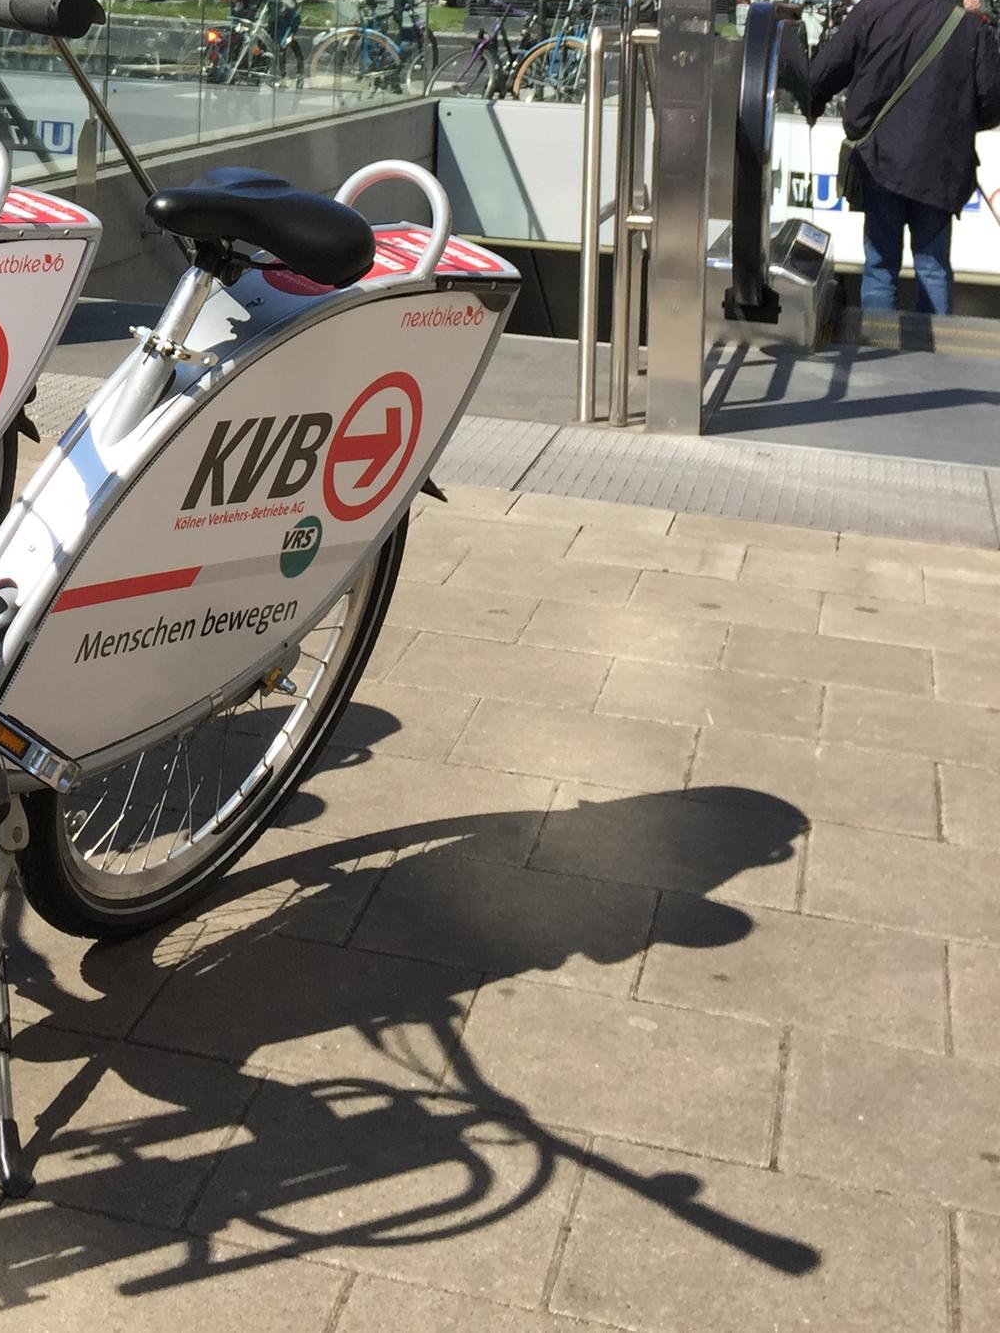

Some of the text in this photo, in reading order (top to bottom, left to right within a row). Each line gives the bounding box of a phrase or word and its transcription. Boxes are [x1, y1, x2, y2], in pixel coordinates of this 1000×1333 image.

[43, 122, 72, 152] U
[401, 306, 462, 328] nextbike
[180, 412, 333, 511] KVB
[174, 501, 305, 531] Kölner Verkehrs-Betriebe AG
[281, 528, 316, 550] VRS
[74, 599, 298, 664] Menschen bewegen
